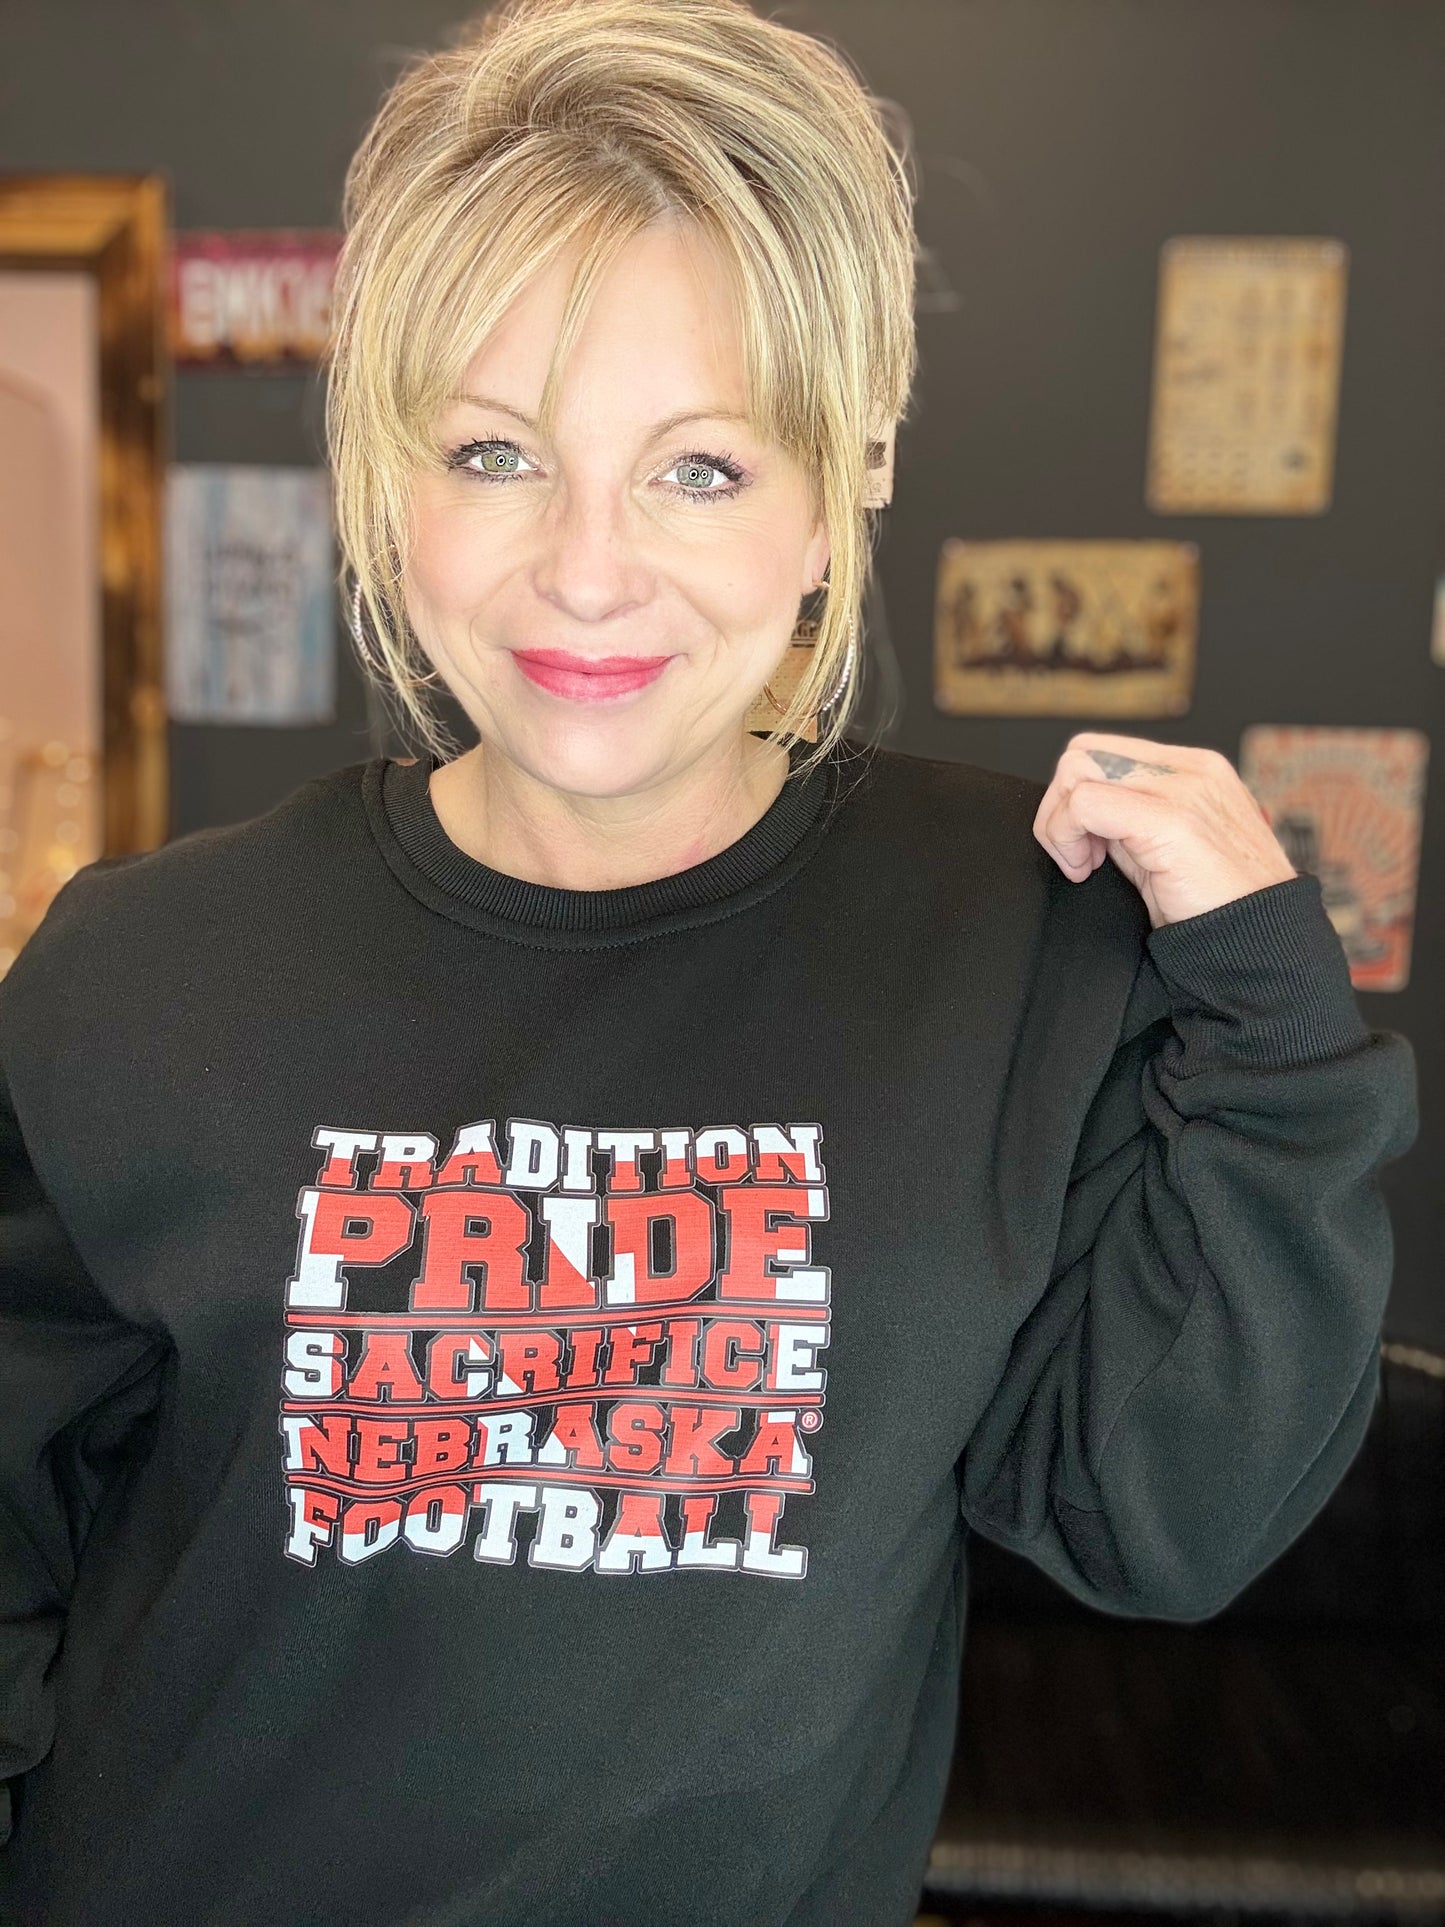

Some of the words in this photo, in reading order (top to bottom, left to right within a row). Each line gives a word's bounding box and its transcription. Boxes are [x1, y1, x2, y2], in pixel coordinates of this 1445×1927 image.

[312, 1120, 822, 1192] TRADITION
[285, 1187, 829, 1312] PRIDE
[283, 1319, 829, 1399] SACRIFICE
[284, 1484, 807, 1578] FOOTBALL
